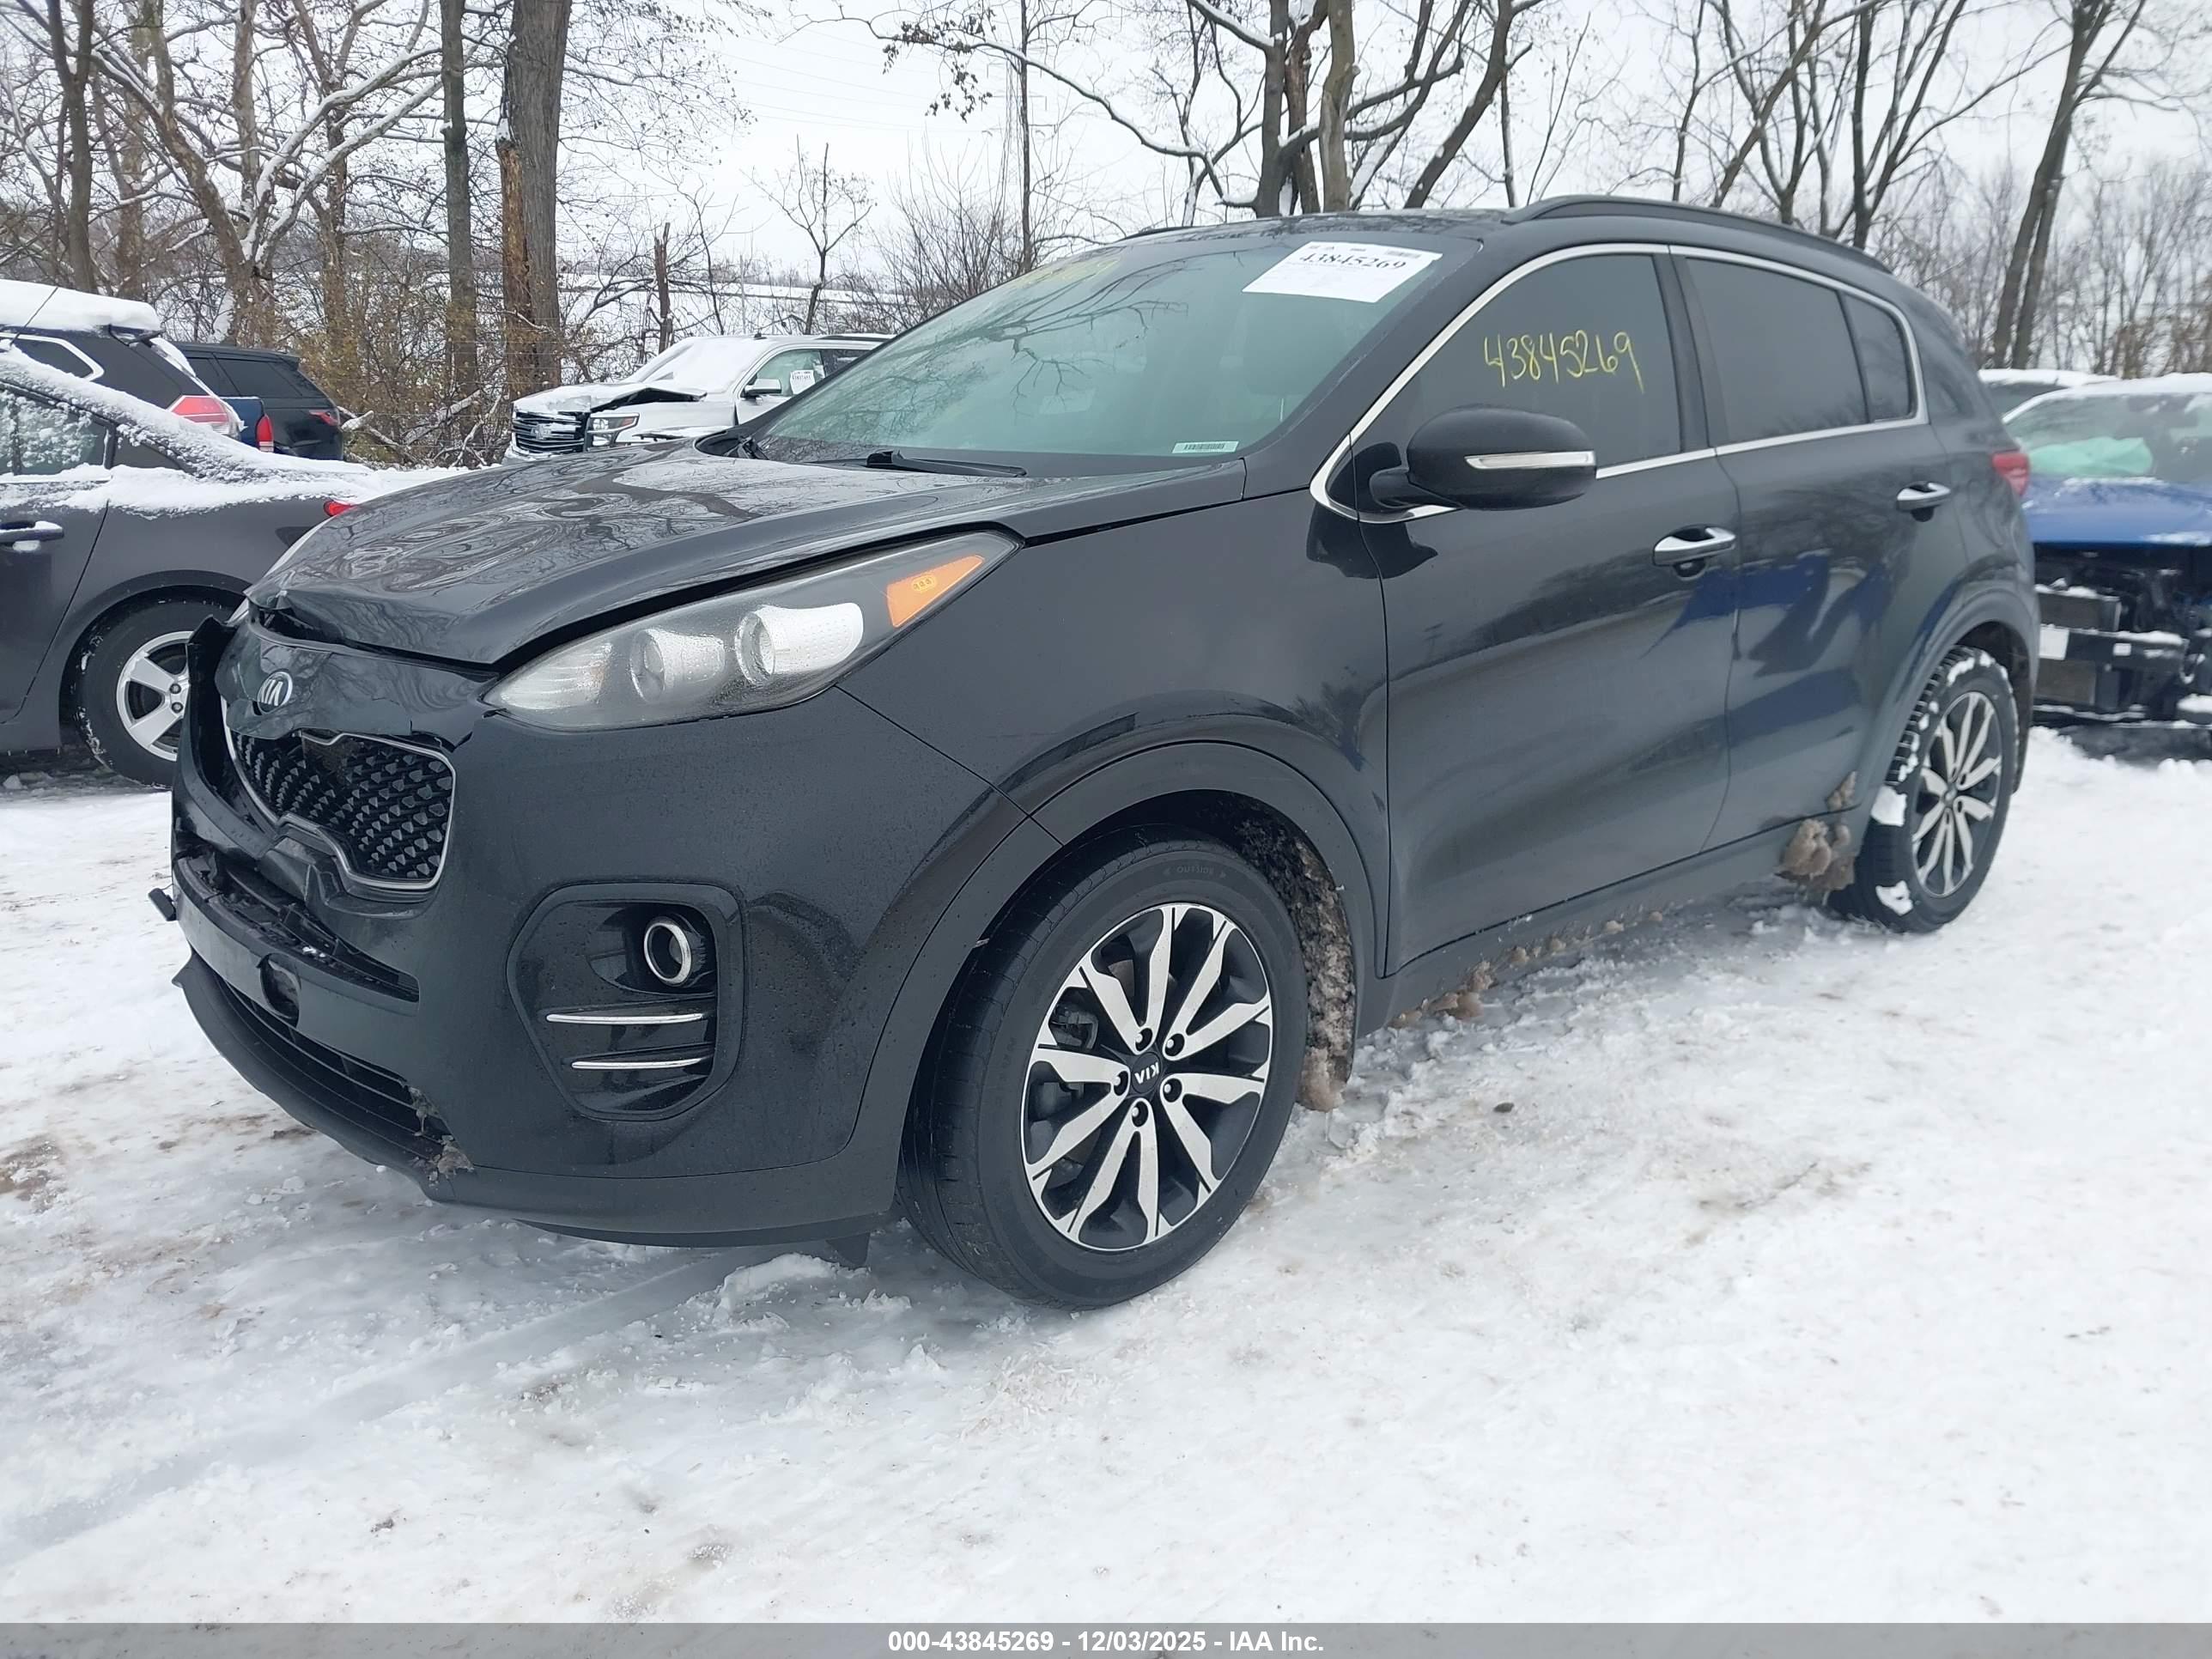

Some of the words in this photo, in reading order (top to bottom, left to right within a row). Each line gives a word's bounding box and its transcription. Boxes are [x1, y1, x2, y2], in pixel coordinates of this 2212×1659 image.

[1298, 252, 1407, 270] 43845269
[1484, 330, 1644, 393] 43845269
[1133, 1061, 1160, 1085] KIA
